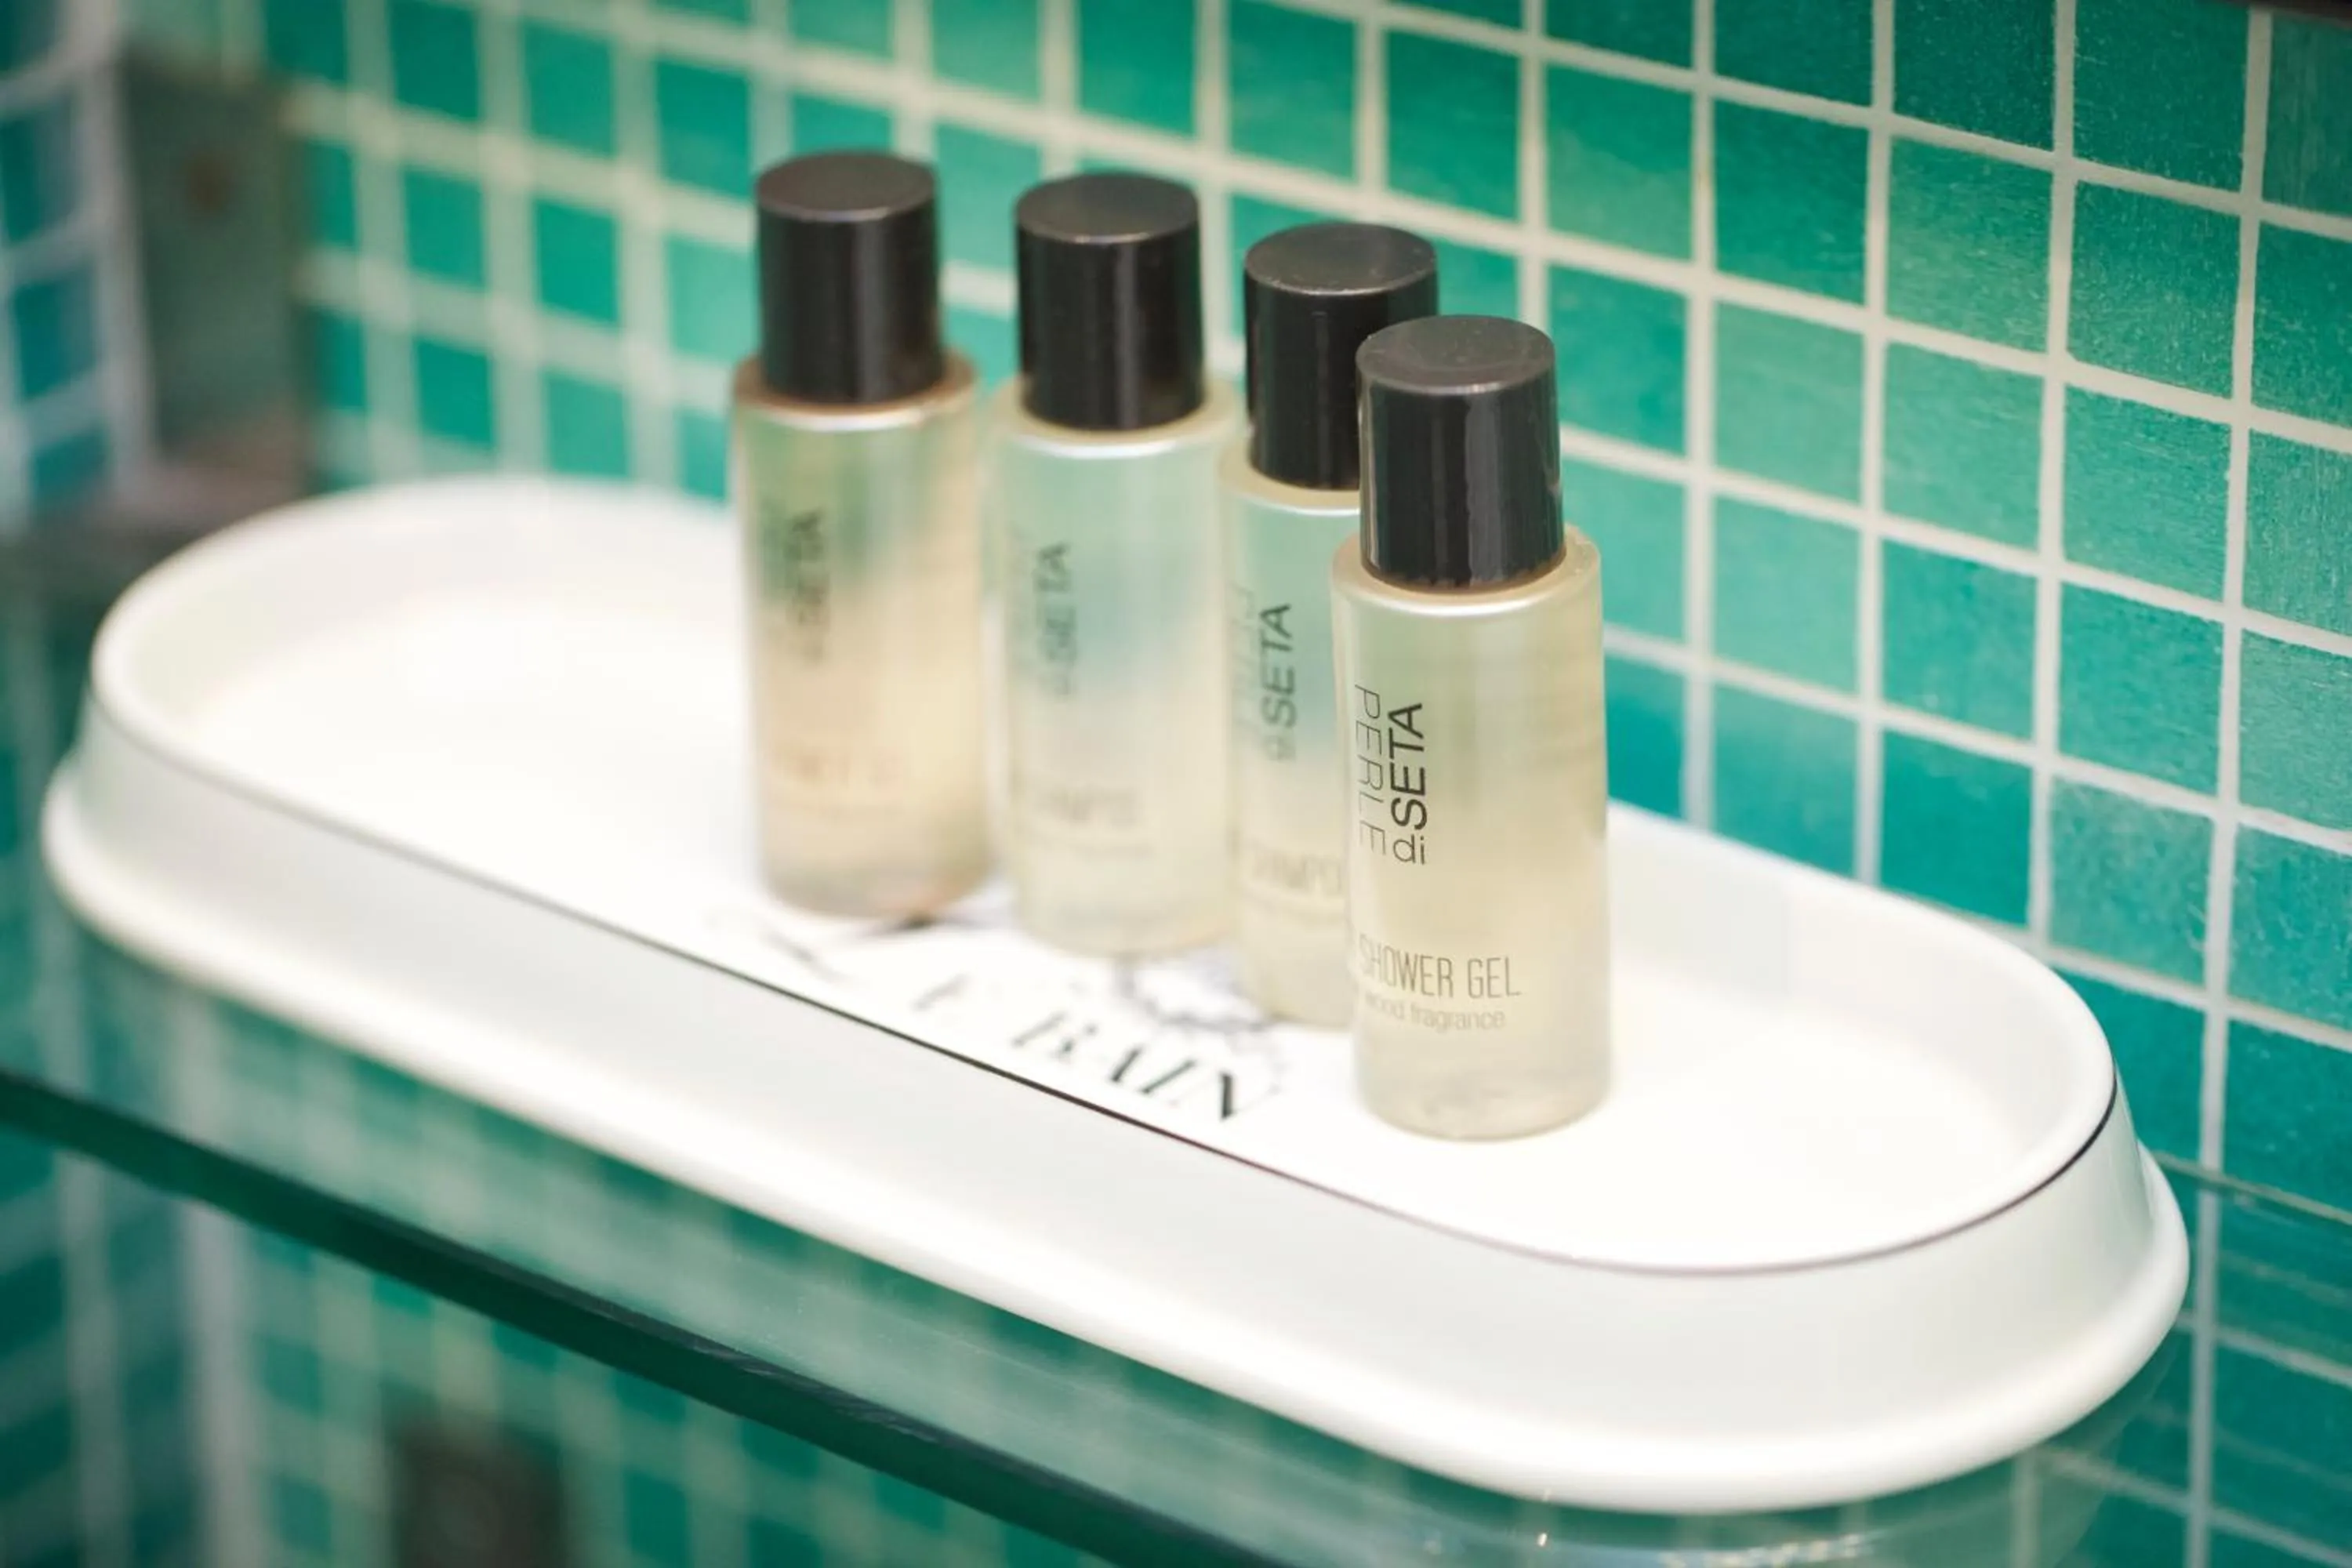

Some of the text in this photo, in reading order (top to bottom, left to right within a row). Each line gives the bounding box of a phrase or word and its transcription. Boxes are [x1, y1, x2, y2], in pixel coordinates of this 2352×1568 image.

[1258, 601, 1298, 729] SETA
[1354, 683, 1387, 856] PERLE
[1387, 702, 1427, 830] SETA
[1392, 833, 1425, 865] di
[1359, 932, 1525, 999] SHOWER GEL
[1410, 1001, 1507, 1035] fragrance
